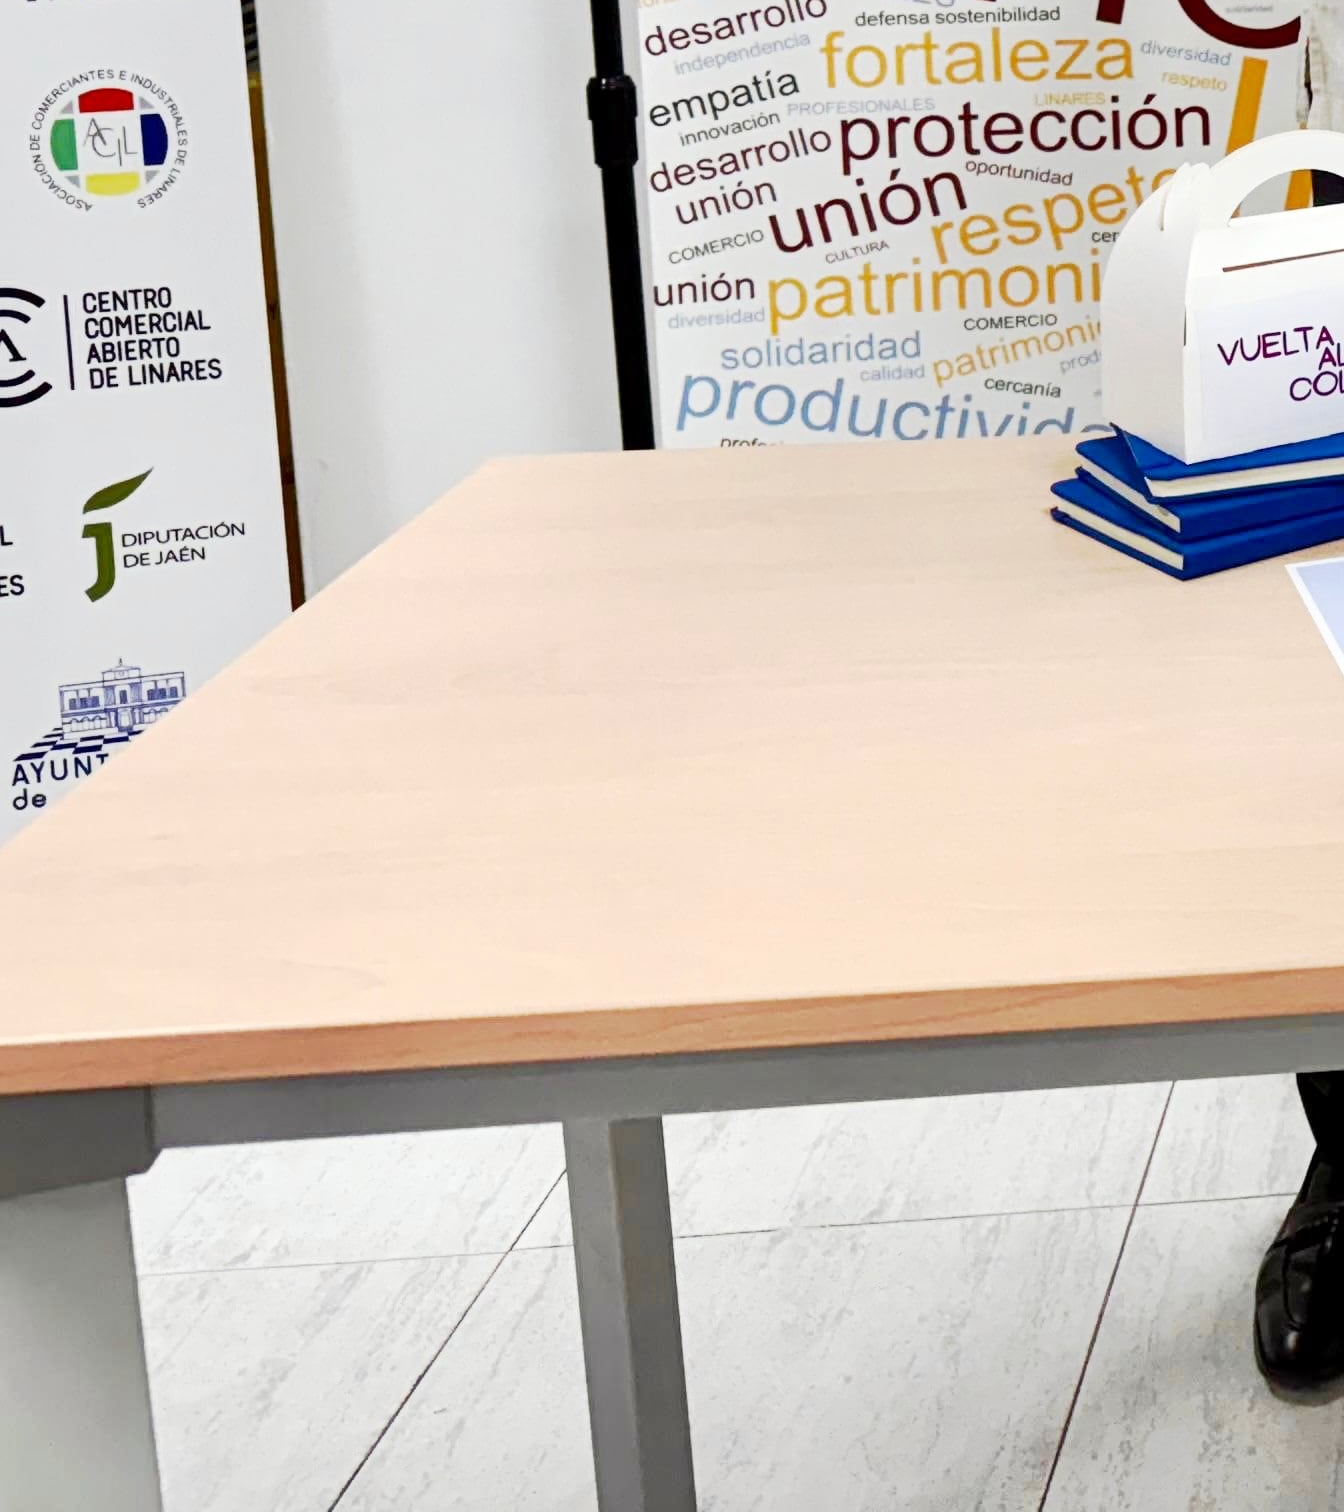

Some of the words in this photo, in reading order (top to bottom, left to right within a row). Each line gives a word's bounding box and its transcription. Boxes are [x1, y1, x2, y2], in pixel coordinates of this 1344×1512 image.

[855, 10, 930, 27] defensa
[935, 7, 1061, 27] sostenibilidad
[820, 26, 1135, 89] fortaleza
[649, 69, 801, 127] empatía
[787, 97, 936, 116] PROFESIONALES
[679, 111, 781, 147] innovación
[840, 93, 1211, 176] protección
[650, 128, 833, 192] desarrollo
[964, 159, 1074, 187] oportunidad
[675, 180, 778, 225] unión
[768, 168, 968, 254] unión
[668, 229, 765, 265] COMERCIO
[83, 287, 172, 314] CENTRO
[653, 272, 756, 307] unión
[85, 309, 211, 340] COMERCIAL
[963, 313, 1058, 332] COMERCIO
[87, 337, 180, 364] ABIERTO
[721, 330, 922, 370] solidaridad
[1217, 325, 1336, 366] VUELTA
[89, 366, 119, 389] DE
[128, 358, 223, 386] LINARES
[121, 521, 246, 548] DIPUTACIÓN
[155, 545, 206, 565] JAÉN
